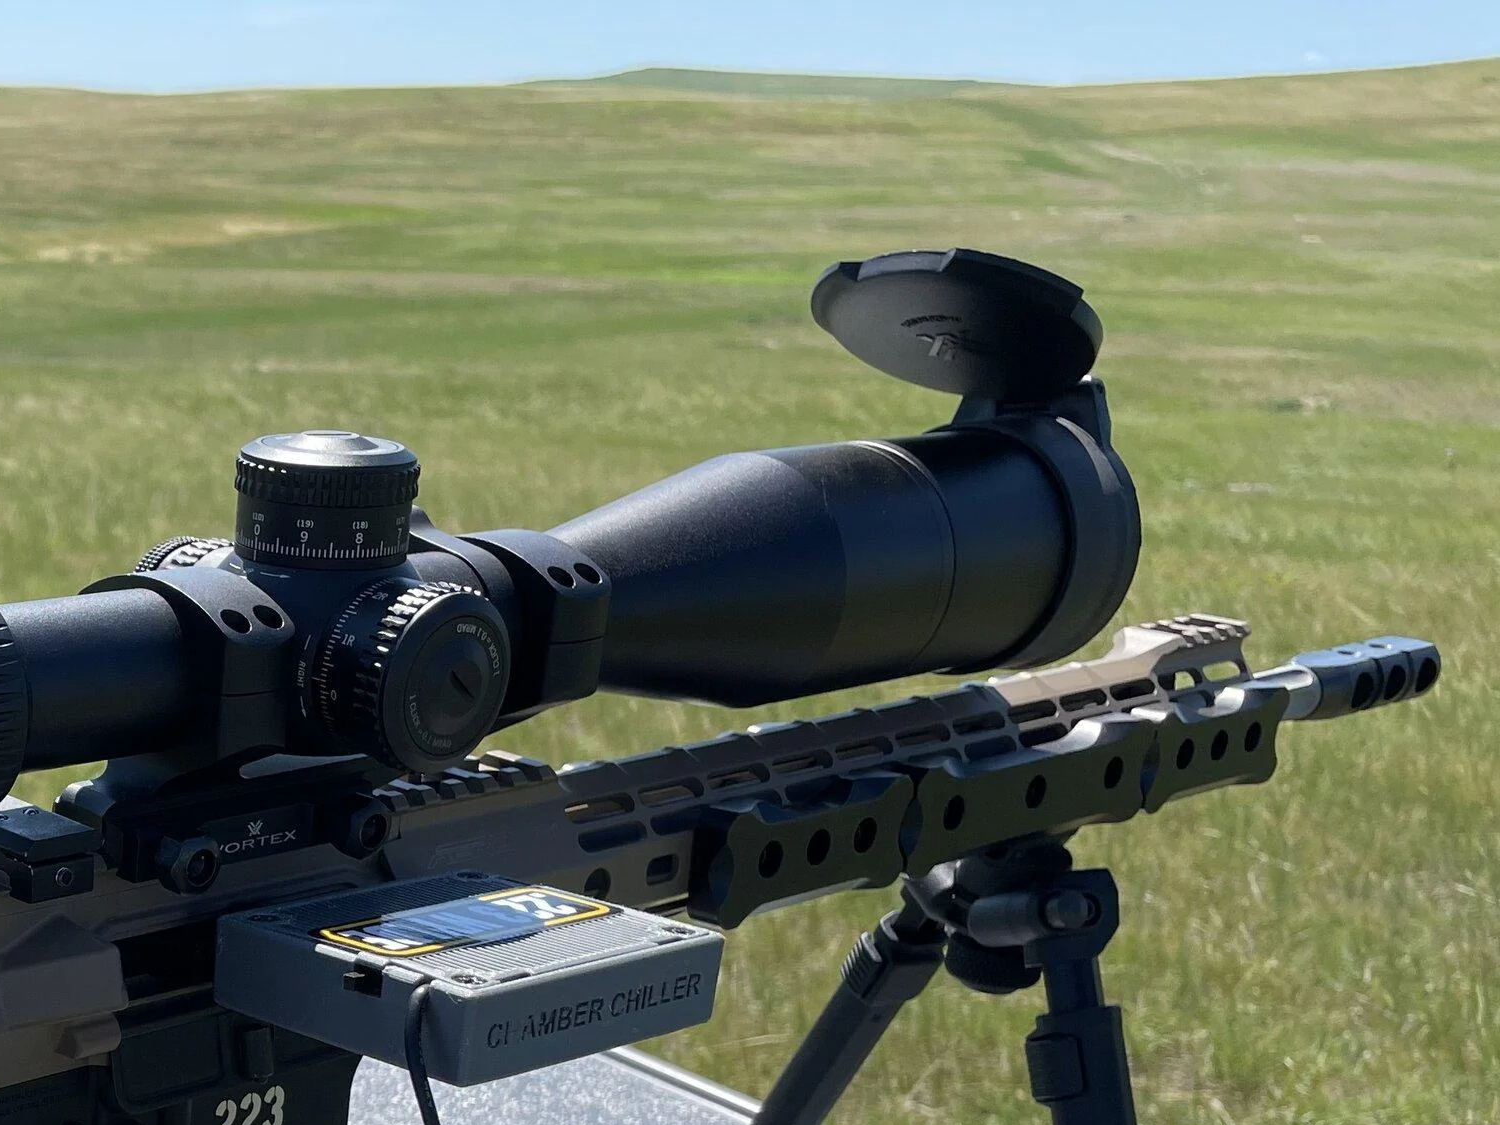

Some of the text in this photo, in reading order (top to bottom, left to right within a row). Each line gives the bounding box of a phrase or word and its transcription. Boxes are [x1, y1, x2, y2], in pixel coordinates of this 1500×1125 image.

[254, 524, 261, 536] 0
[300, 531, 309, 543] 9
[355, 532, 364, 544] 8
[297, 519, 314, 529] (19)
[352, 521, 369, 530] (18)
[341, 634, 356, 648] 1R
[297, 660, 307, 688] RIGHT
[220, 829, 297, 854] ORTEX
[486, 973, 702, 1049] CHAMBER CHILLER
